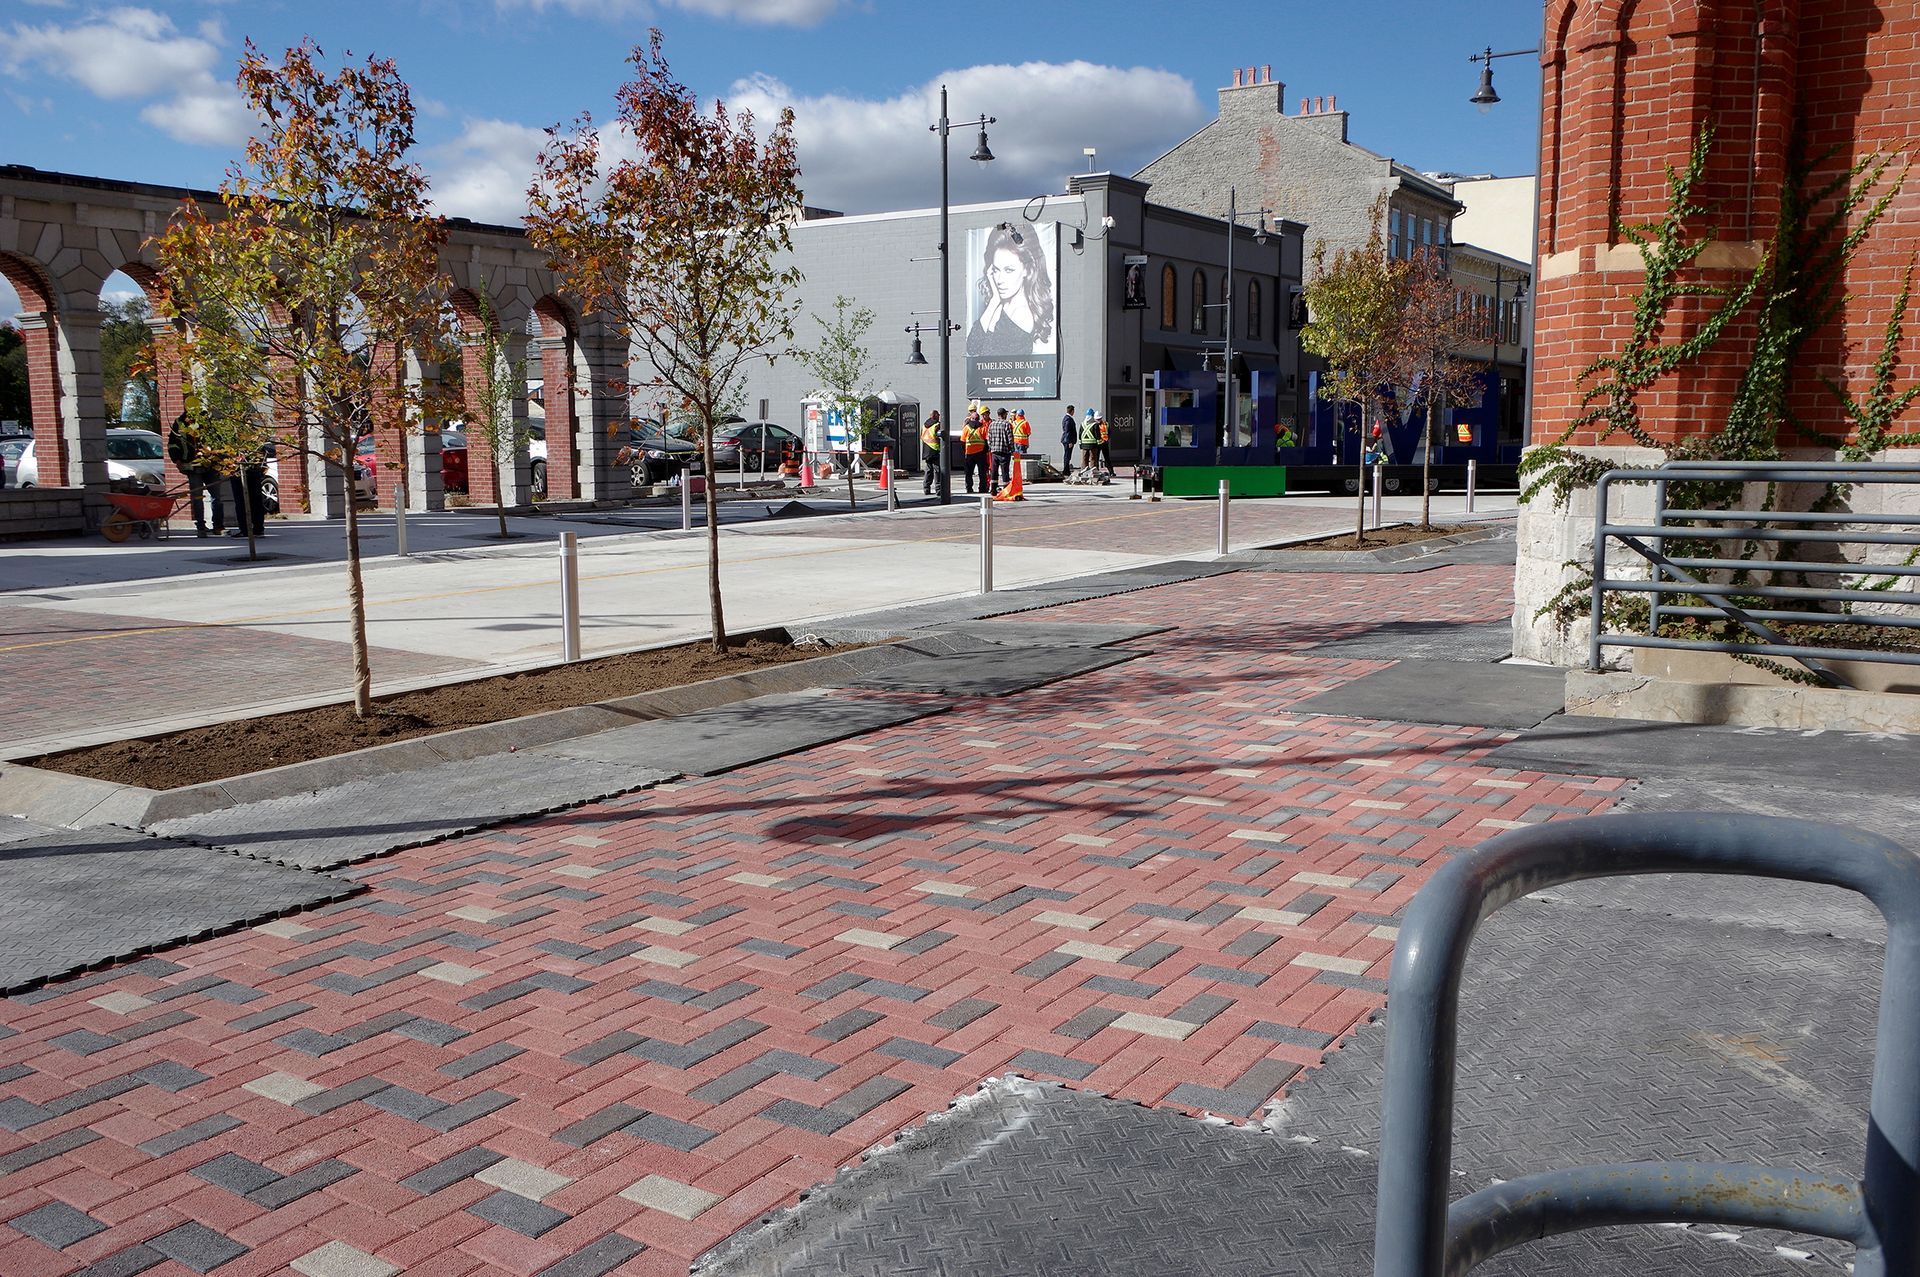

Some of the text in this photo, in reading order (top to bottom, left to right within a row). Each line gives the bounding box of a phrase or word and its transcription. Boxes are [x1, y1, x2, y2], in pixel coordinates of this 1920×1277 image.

[976, 360, 1046, 370] TIMELESS BEAUTY
[982, 376, 1040, 385] THE SALON
